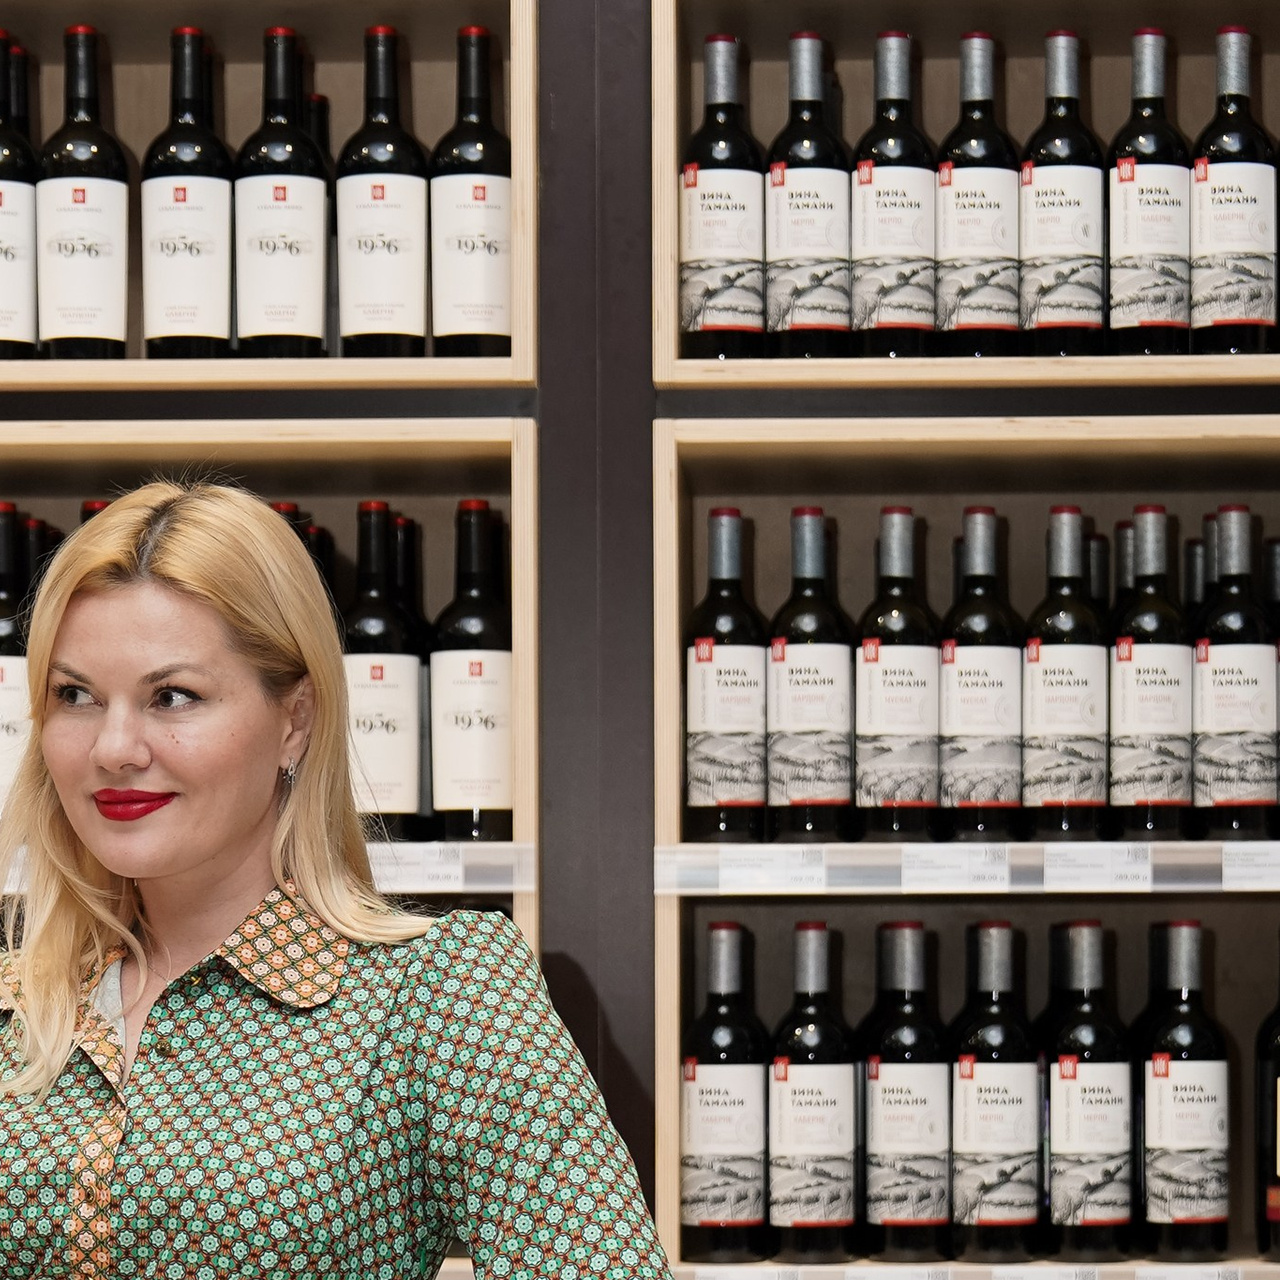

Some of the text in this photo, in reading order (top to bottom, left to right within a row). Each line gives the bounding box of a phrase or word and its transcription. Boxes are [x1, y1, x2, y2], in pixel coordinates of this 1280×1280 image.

[875, 189, 907, 198] ВИНА
[954, 190, 986, 199] ВИНА
[1035, 189, 1066, 197] ВИНА
[1138, 187, 1170, 196] ВИНА
[1210, 186, 1243, 194] ВИНА
[700, 192, 732, 200] ВИНА
[788, 191, 820, 200] ВИНА
[875, 200, 921, 210] ТАМАНИ
[1035, 199, 1081, 208] ТАМАНИ
[1138, 198, 1182, 207] ТАМАНИ
[1210, 196, 1257, 205] ТАМАНИ
[700, 203, 746, 212] ТАМАНИ
[788, 202, 834, 211] ТАМАНИ
[954, 202, 1000, 210] ТАМАНИ
[57, 236, 100, 258] 1956
[159, 235, 201, 257] 1956
[258, 234, 301, 257] 1956
[357, 233, 399, 256] 1956
[457, 233, 499, 256] 1956
[716, 668, 747, 677] ВИНА
[788, 667, 820, 676] ВИНА
[882, 668, 914, 677] ВИНА
[957, 668, 988, 678] ВИНА
[1042, 667, 1073, 677] ВИНА
[1135, 667, 1167, 676] ВИНА
[1211, 667, 1243, 676] ВИНА
[716, 679, 759, 688] ТАМАНИ
[788, 677, 834, 687] ТАМАНИ
[882, 679, 927, 688] ТАМАНИ
[957, 679, 1003, 688] ТАМАНИ
[1042, 678, 1088, 687] ТАМАНИ
[1135, 677, 1180, 687] ТАМАНИ
[1212, 677, 1258, 687] ТАМАНИ
[355, 713, 397, 734] 1956
[454, 710, 495, 730] 1956
[698, 1087, 729, 1096] ВИНА
[791, 1087, 822, 1096] ВИНА
[881, 1086, 912, 1095] ВИНА
[976, 1086, 1008, 1095] ВИНА
[1080, 1086, 1112, 1095] ВИНА
[1172, 1084, 1204, 1093] ВИНА
[698, 1098, 744, 1107] ТАМАНИ
[791, 1098, 837, 1107] ТАМАНИ
[881, 1097, 927, 1106] ТАМАНИ
[977, 1096, 1022, 1105] ТАМАНИ
[1081, 1096, 1123, 1105] ТАМАНИ
[1172, 1094, 1217, 1104] ТАМАНИ
